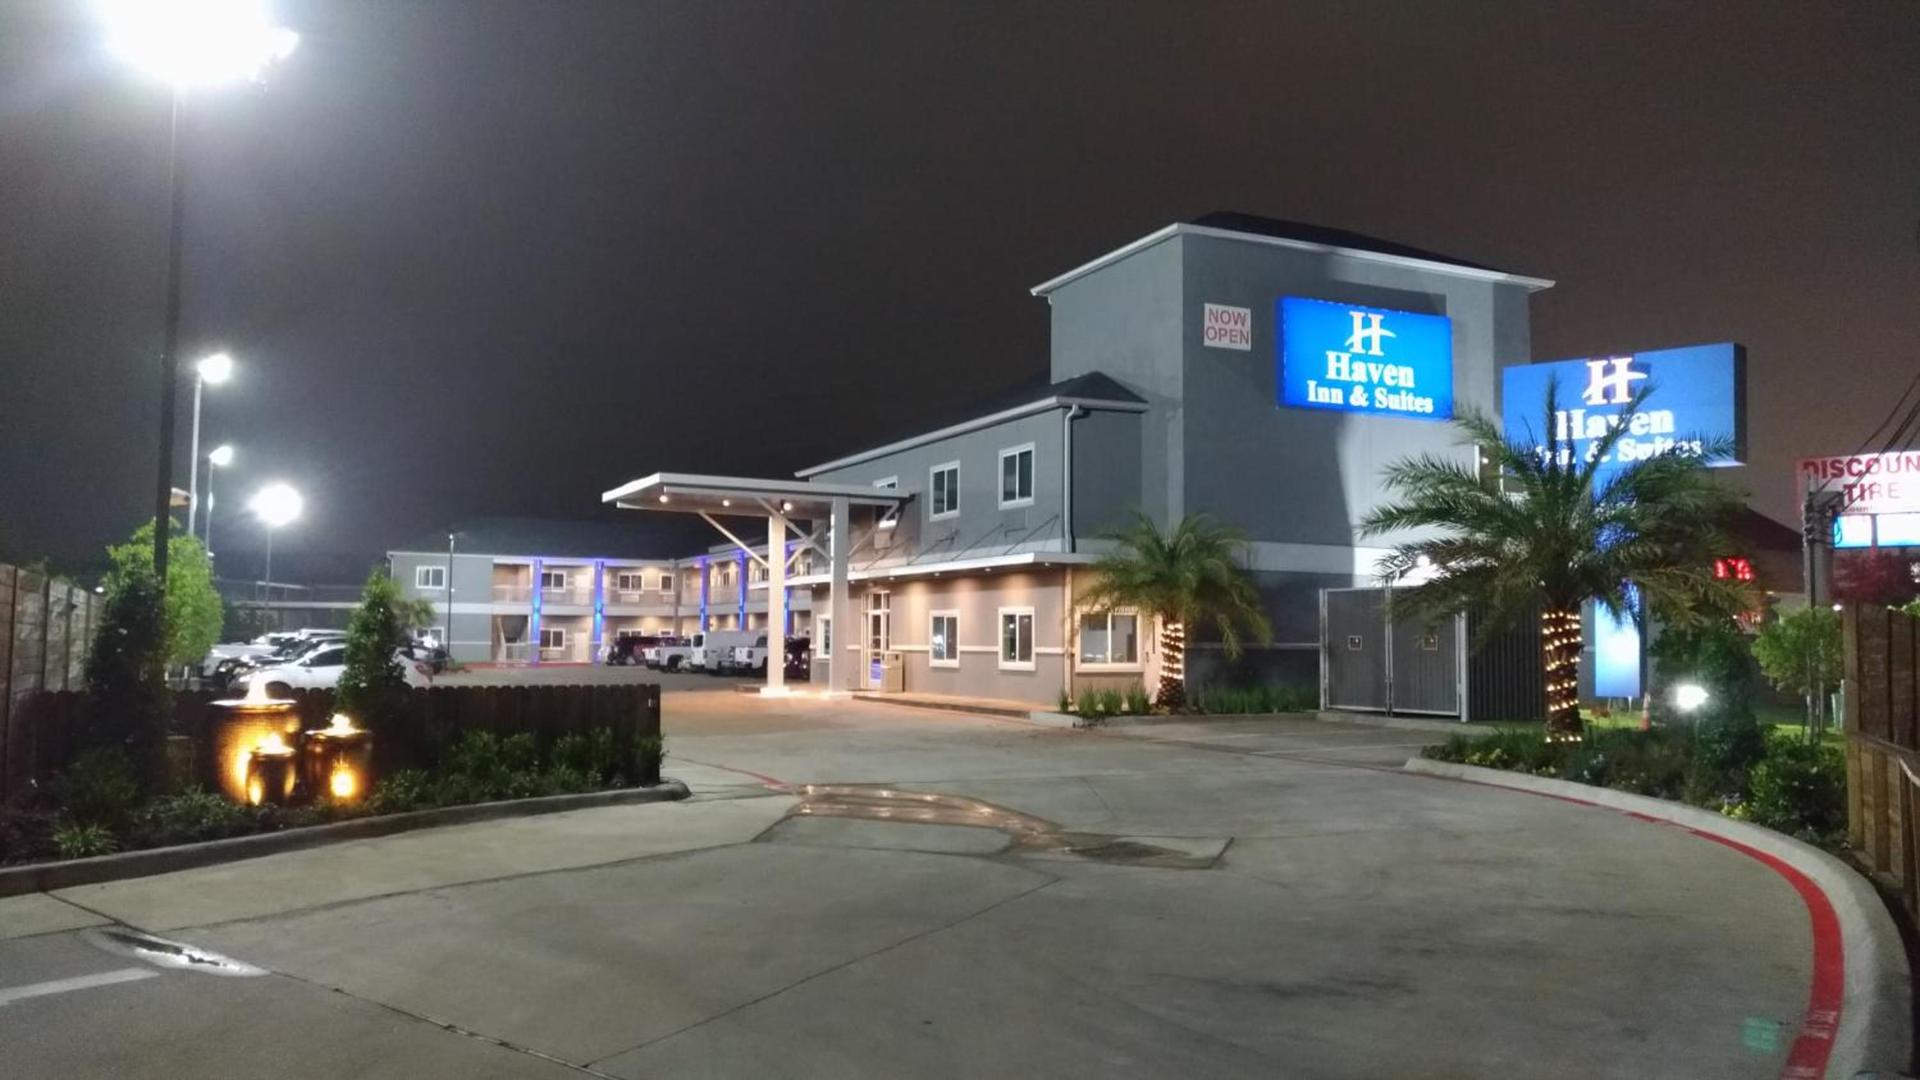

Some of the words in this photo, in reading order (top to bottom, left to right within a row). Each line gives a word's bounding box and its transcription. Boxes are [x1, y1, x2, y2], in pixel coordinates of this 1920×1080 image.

[1208, 308, 1247, 327] NOW
[1345, 311, 1393, 356] H
[1206, 326, 1250, 345] OPEN
[1326, 351, 1415, 388] Haven
[1585, 357, 1643, 406] H
[1307, 380, 1344, 404] Inn
[1349, 385, 1369, 408] &
[1375, 387, 1434, 413] Suites
[1843, 482, 1902, 502] TIRE
